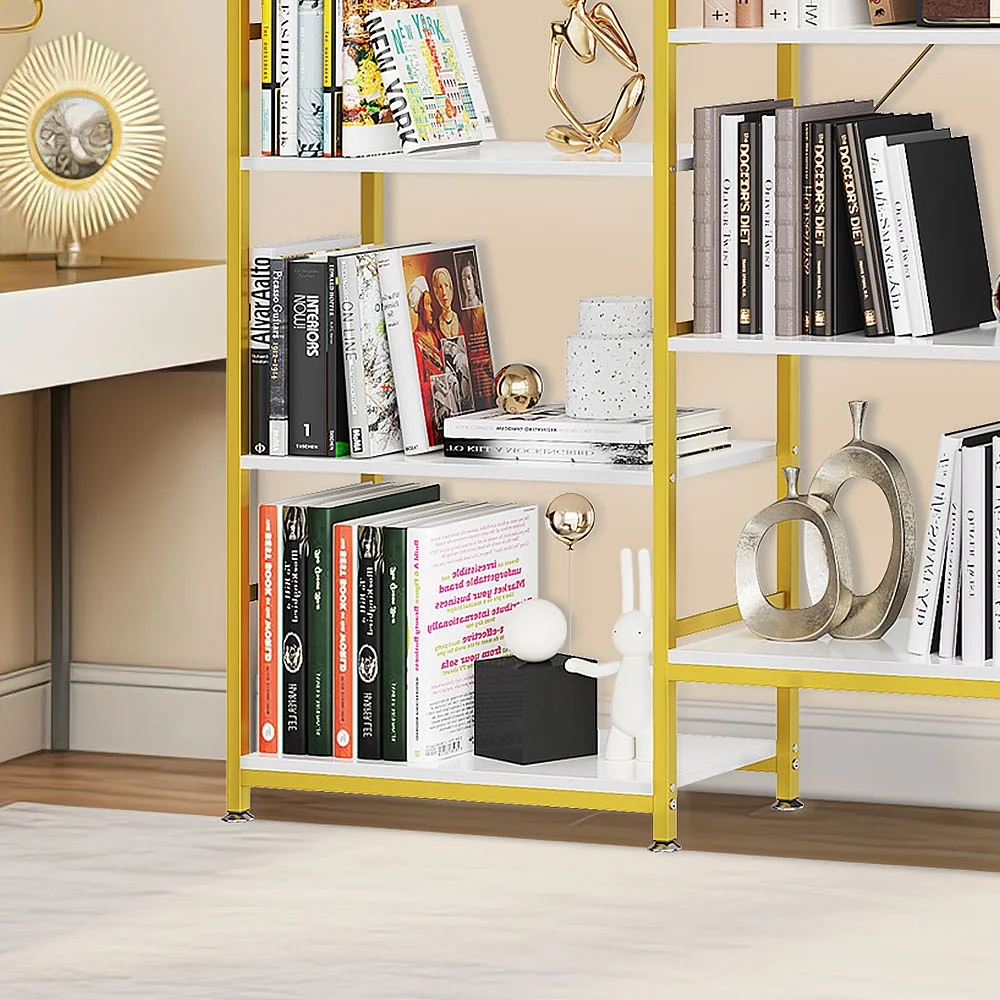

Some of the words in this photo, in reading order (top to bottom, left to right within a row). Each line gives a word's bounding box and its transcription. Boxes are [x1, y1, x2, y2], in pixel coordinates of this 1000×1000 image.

[281, 6, 289, 86] FASHION
[391, 20, 414, 54] NEW
[411, 14, 445, 41] YORK
[366, 13, 396, 72] NEW
[385, 78, 418, 148] YORK
[280, 94, 289, 147] BOOK
[723, 178, 732, 226] OLIVER
[765, 178, 774, 227] OLIVER
[722, 230, 732, 268] TWIST
[740, 216, 750, 246] DIET
[765, 230, 774, 268] TWIST
[814, 216, 824, 248] DIET
[850, 215, 864, 247] DIET
[895, 200, 906, 244] OLIVER
[902, 246, 912, 280] TWIST
[272, 270, 283, 304] Picasso
[272, 304, 283, 338] Guitars
[294, 295, 306, 329] NOW!
[306, 295, 320, 357] INTERIORS
[342, 302, 353, 325] ON
[344, 328, 358, 361] LINE
[304, 424, 311, 438] 1
[352, 429, 362, 452] MoMA
